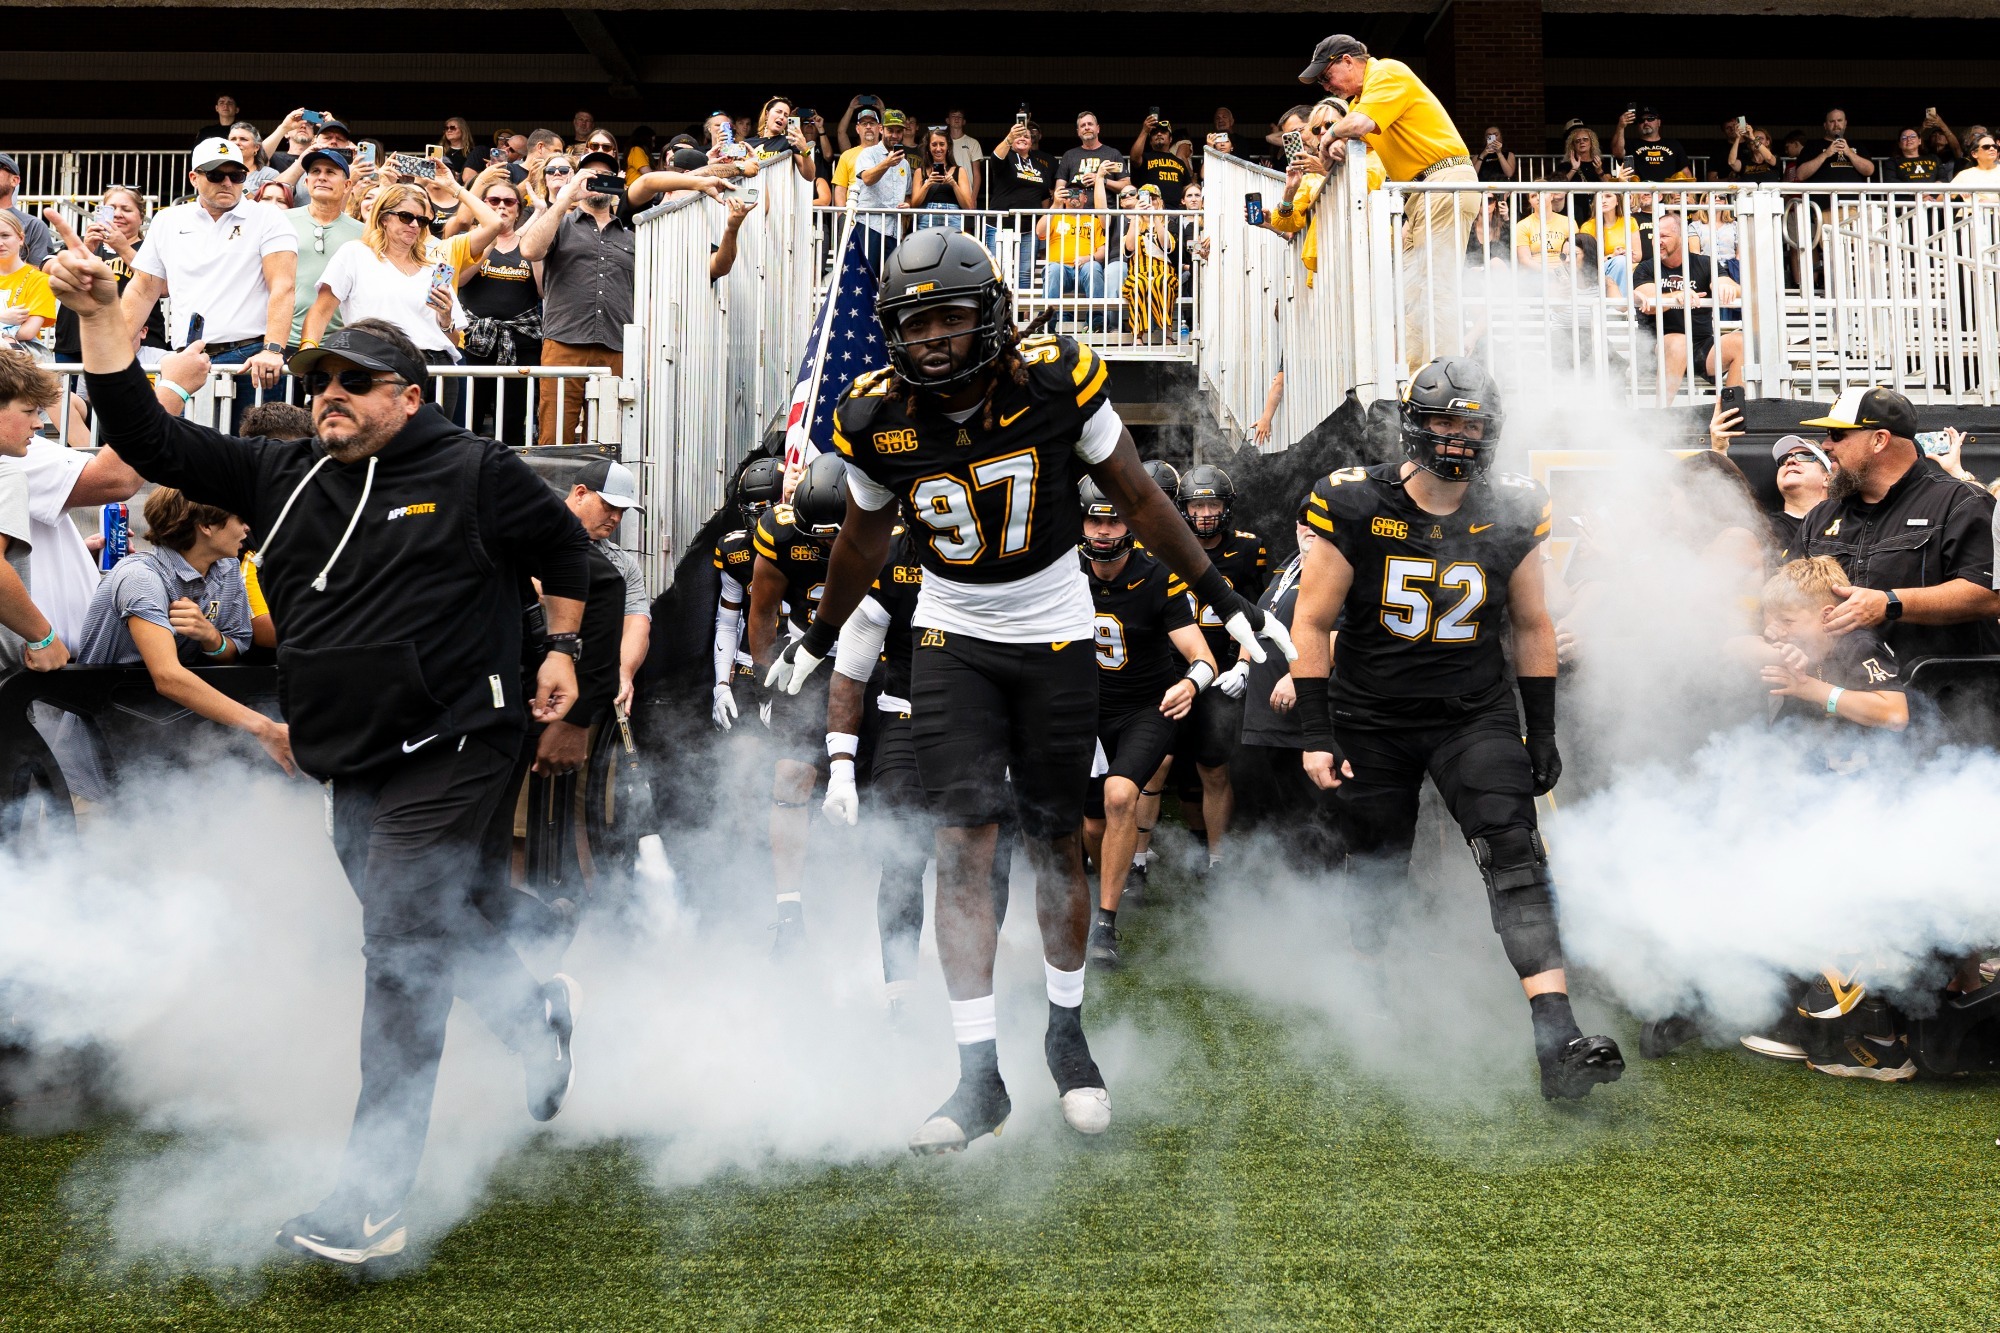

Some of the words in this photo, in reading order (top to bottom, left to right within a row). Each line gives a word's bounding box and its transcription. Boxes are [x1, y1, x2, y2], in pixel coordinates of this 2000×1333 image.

[1158, 170, 1179, 182] STATE
[873, 428, 919, 454] SBC
[956, 429, 971, 446] A
[387, 503, 436, 520] APPSTATE
[909, 447, 1040, 565] 97
[1371, 516, 1409, 540] SBC
[1430, 525, 1443, 539] A
[118, 521, 127, 560] ULTRA
[727, 550, 750, 565] SBC
[791, 546, 820, 561] SBC
[1380, 555, 1487, 643] 52
[1094, 612, 1129, 671] 9
[1862, 657, 1898, 684] A
[1852, 1046, 1872, 1064] NIKE
